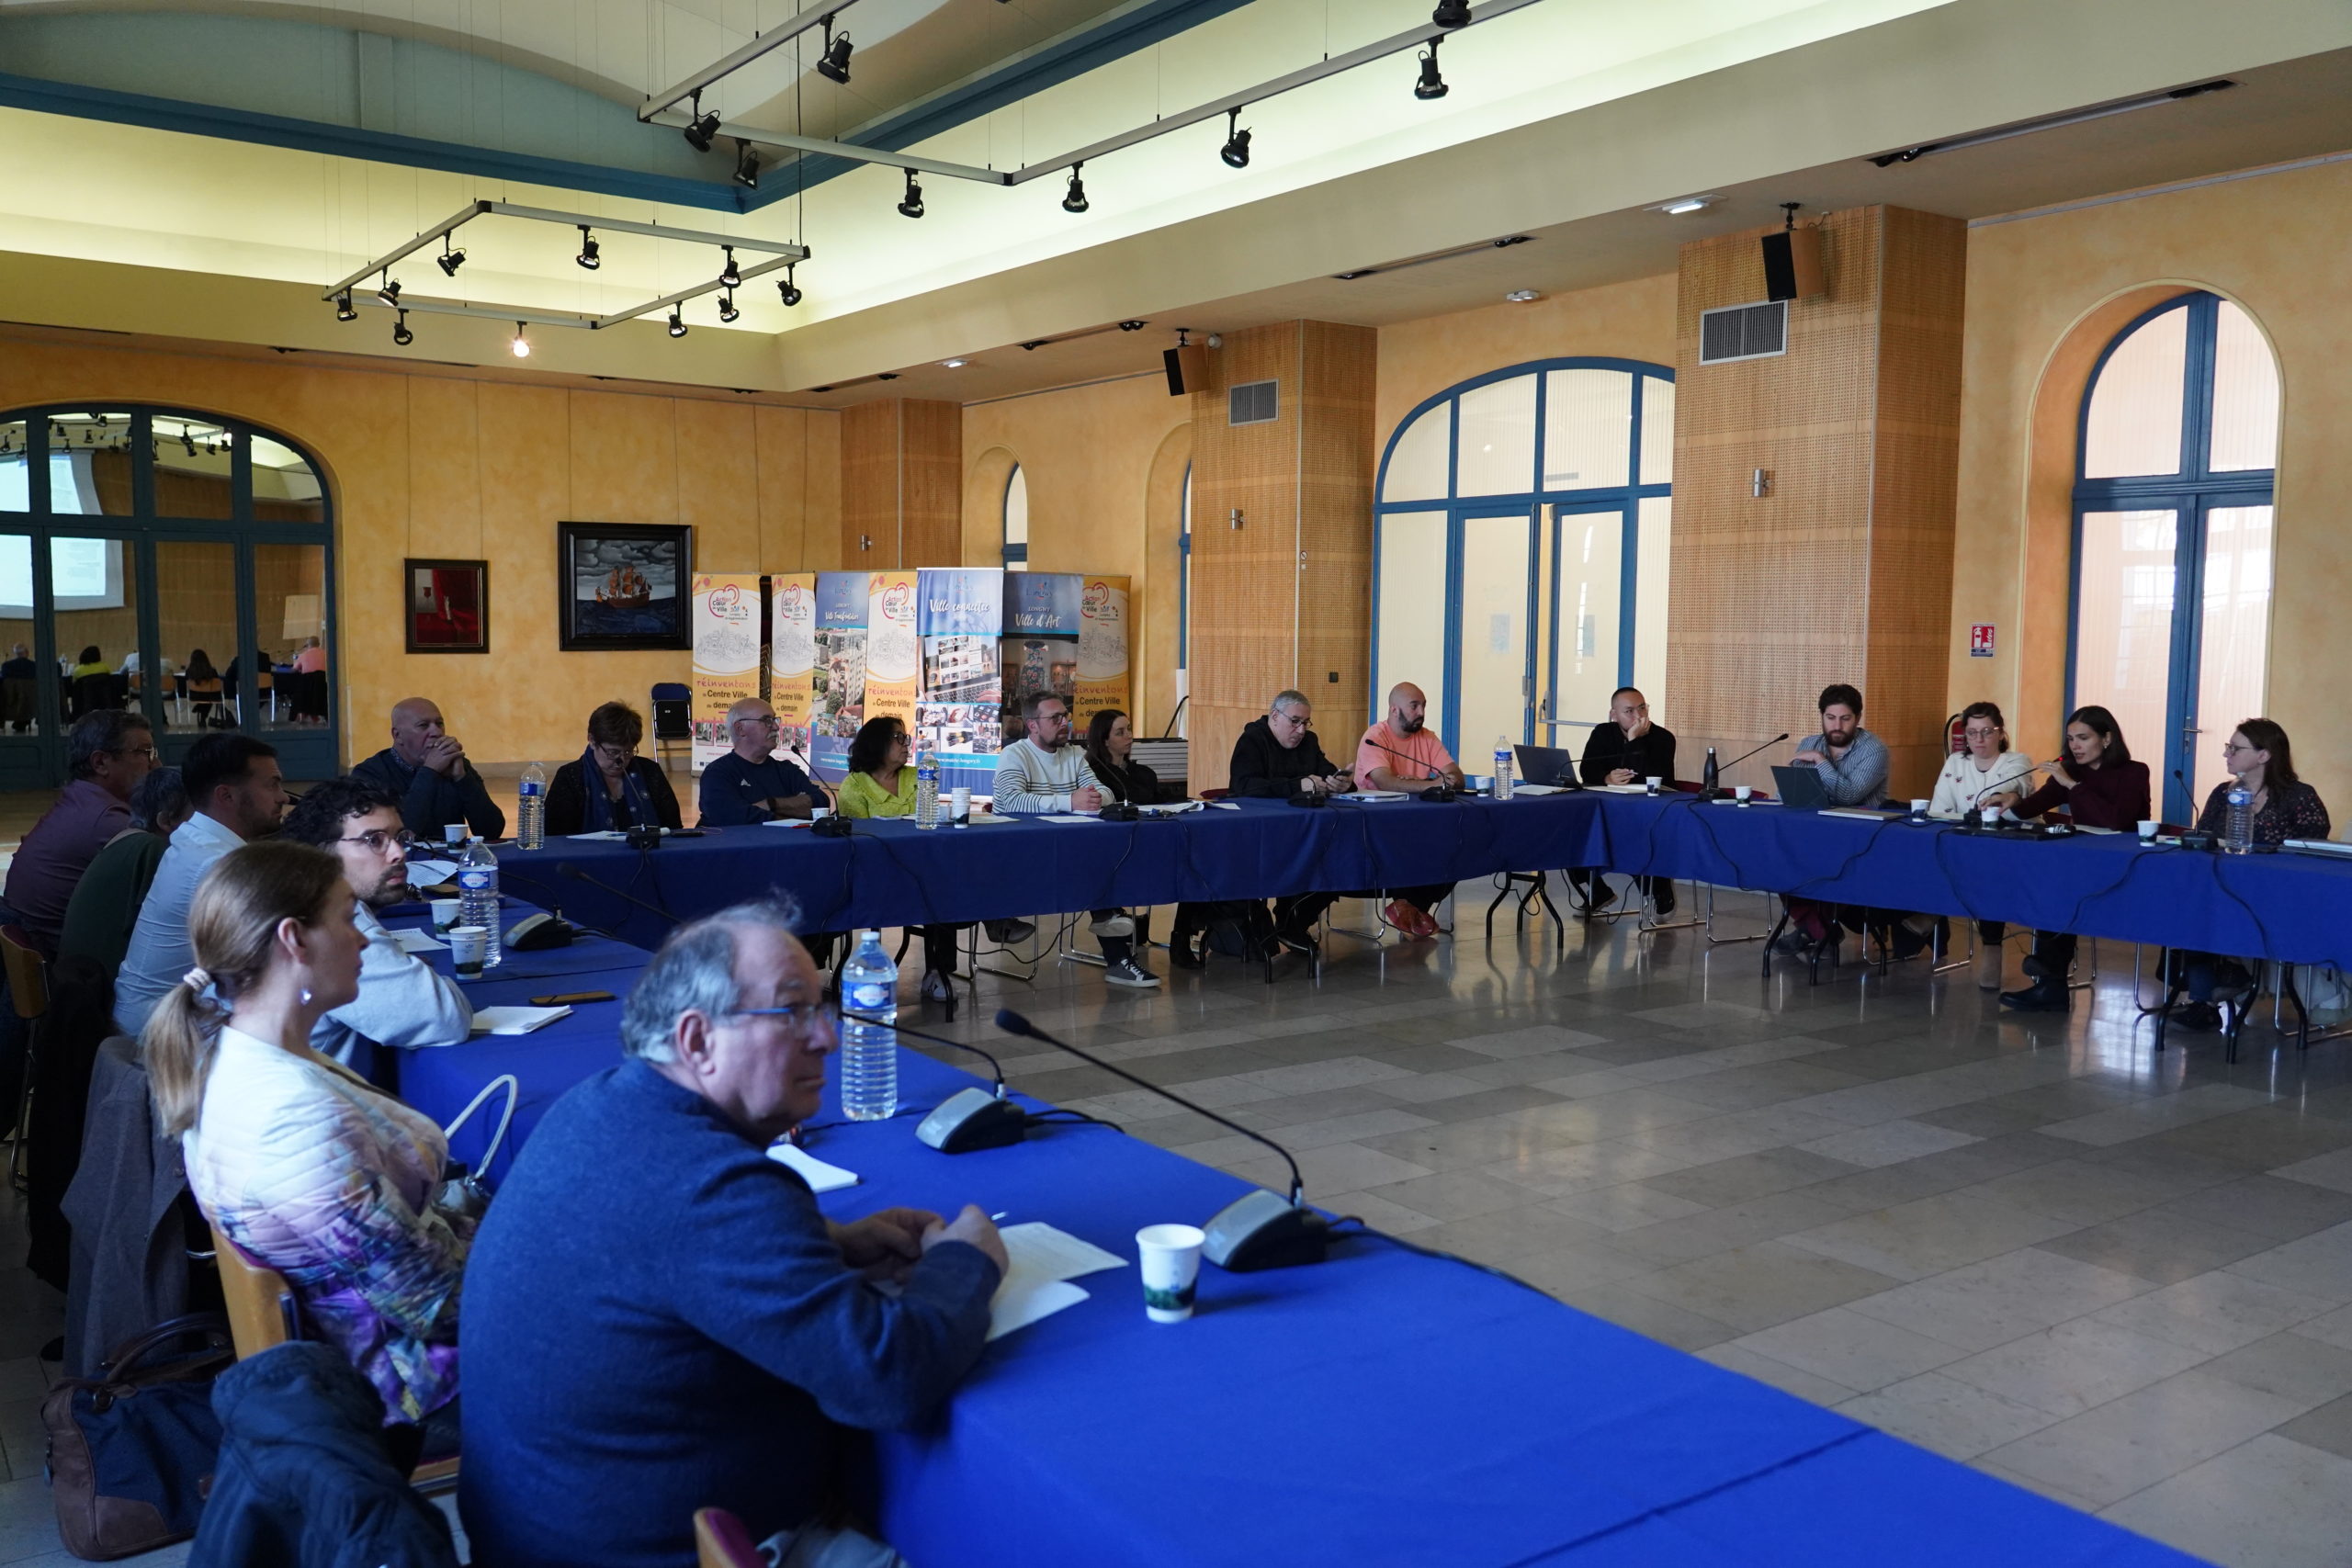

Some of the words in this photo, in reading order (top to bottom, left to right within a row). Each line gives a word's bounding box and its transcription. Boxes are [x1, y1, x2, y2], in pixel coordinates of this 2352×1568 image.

[929, 598, 950, 613] Ville
[1015, 613, 1035, 627] Ville
[1036, 613, 1062, 628] d'Art
[696, 677, 756, 689] réinventons
[1073, 683, 1129, 694] éinventons
[707, 689, 731, 698] Centre
[732, 691, 749, 699] Ville
[867, 684, 914, 696] réinventon
[776, 692, 793, 701] Centre
[1080, 696, 1103, 705] Centre
[1104, 696, 1121, 705] Ville
[876, 698, 897, 707] Centre
[898, 699, 910, 707] Ville
